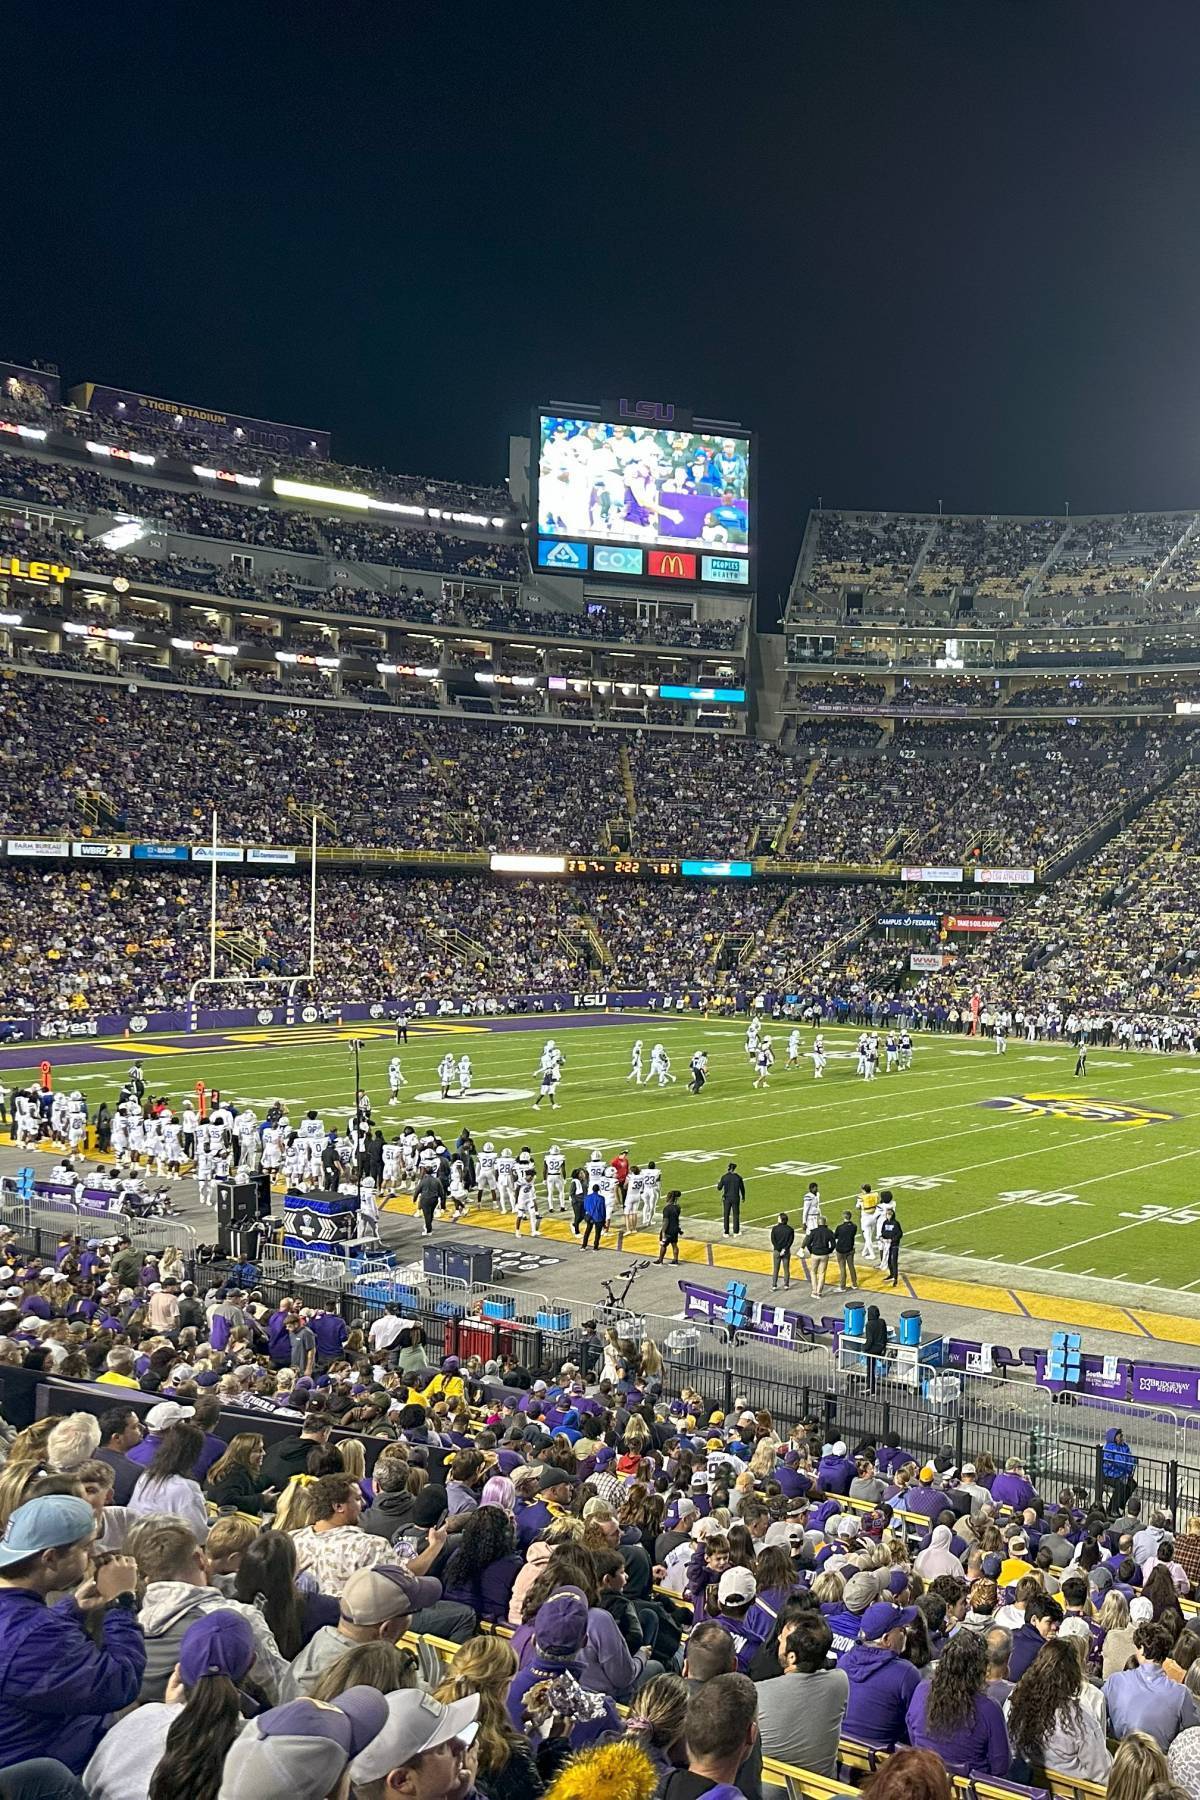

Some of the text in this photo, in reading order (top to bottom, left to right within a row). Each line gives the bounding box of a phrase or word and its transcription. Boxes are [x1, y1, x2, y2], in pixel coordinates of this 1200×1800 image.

[148, 401, 179, 414] TIGER
[181, 407, 227, 424] STADIUM
[619, 399, 674, 421] LSU
[597, 551, 640, 567] COX
[712, 559, 740, 570] PEOPLES
[899, 750, 915, 759] 422
[1046, 752, 1062, 760] 423
[82, 846, 107, 855] WBRZ
[615, 861, 640, 873] 2:22
[878, 918, 937, 927] CAMPUS FEDERAL
[755, 1160, 842, 1176] 50
[998, 1189, 1080, 1207] 40
[1150, 1378, 1190, 1391] BRIDGEWAY
[1157, 1386, 1183, 1394] HOSPICE
